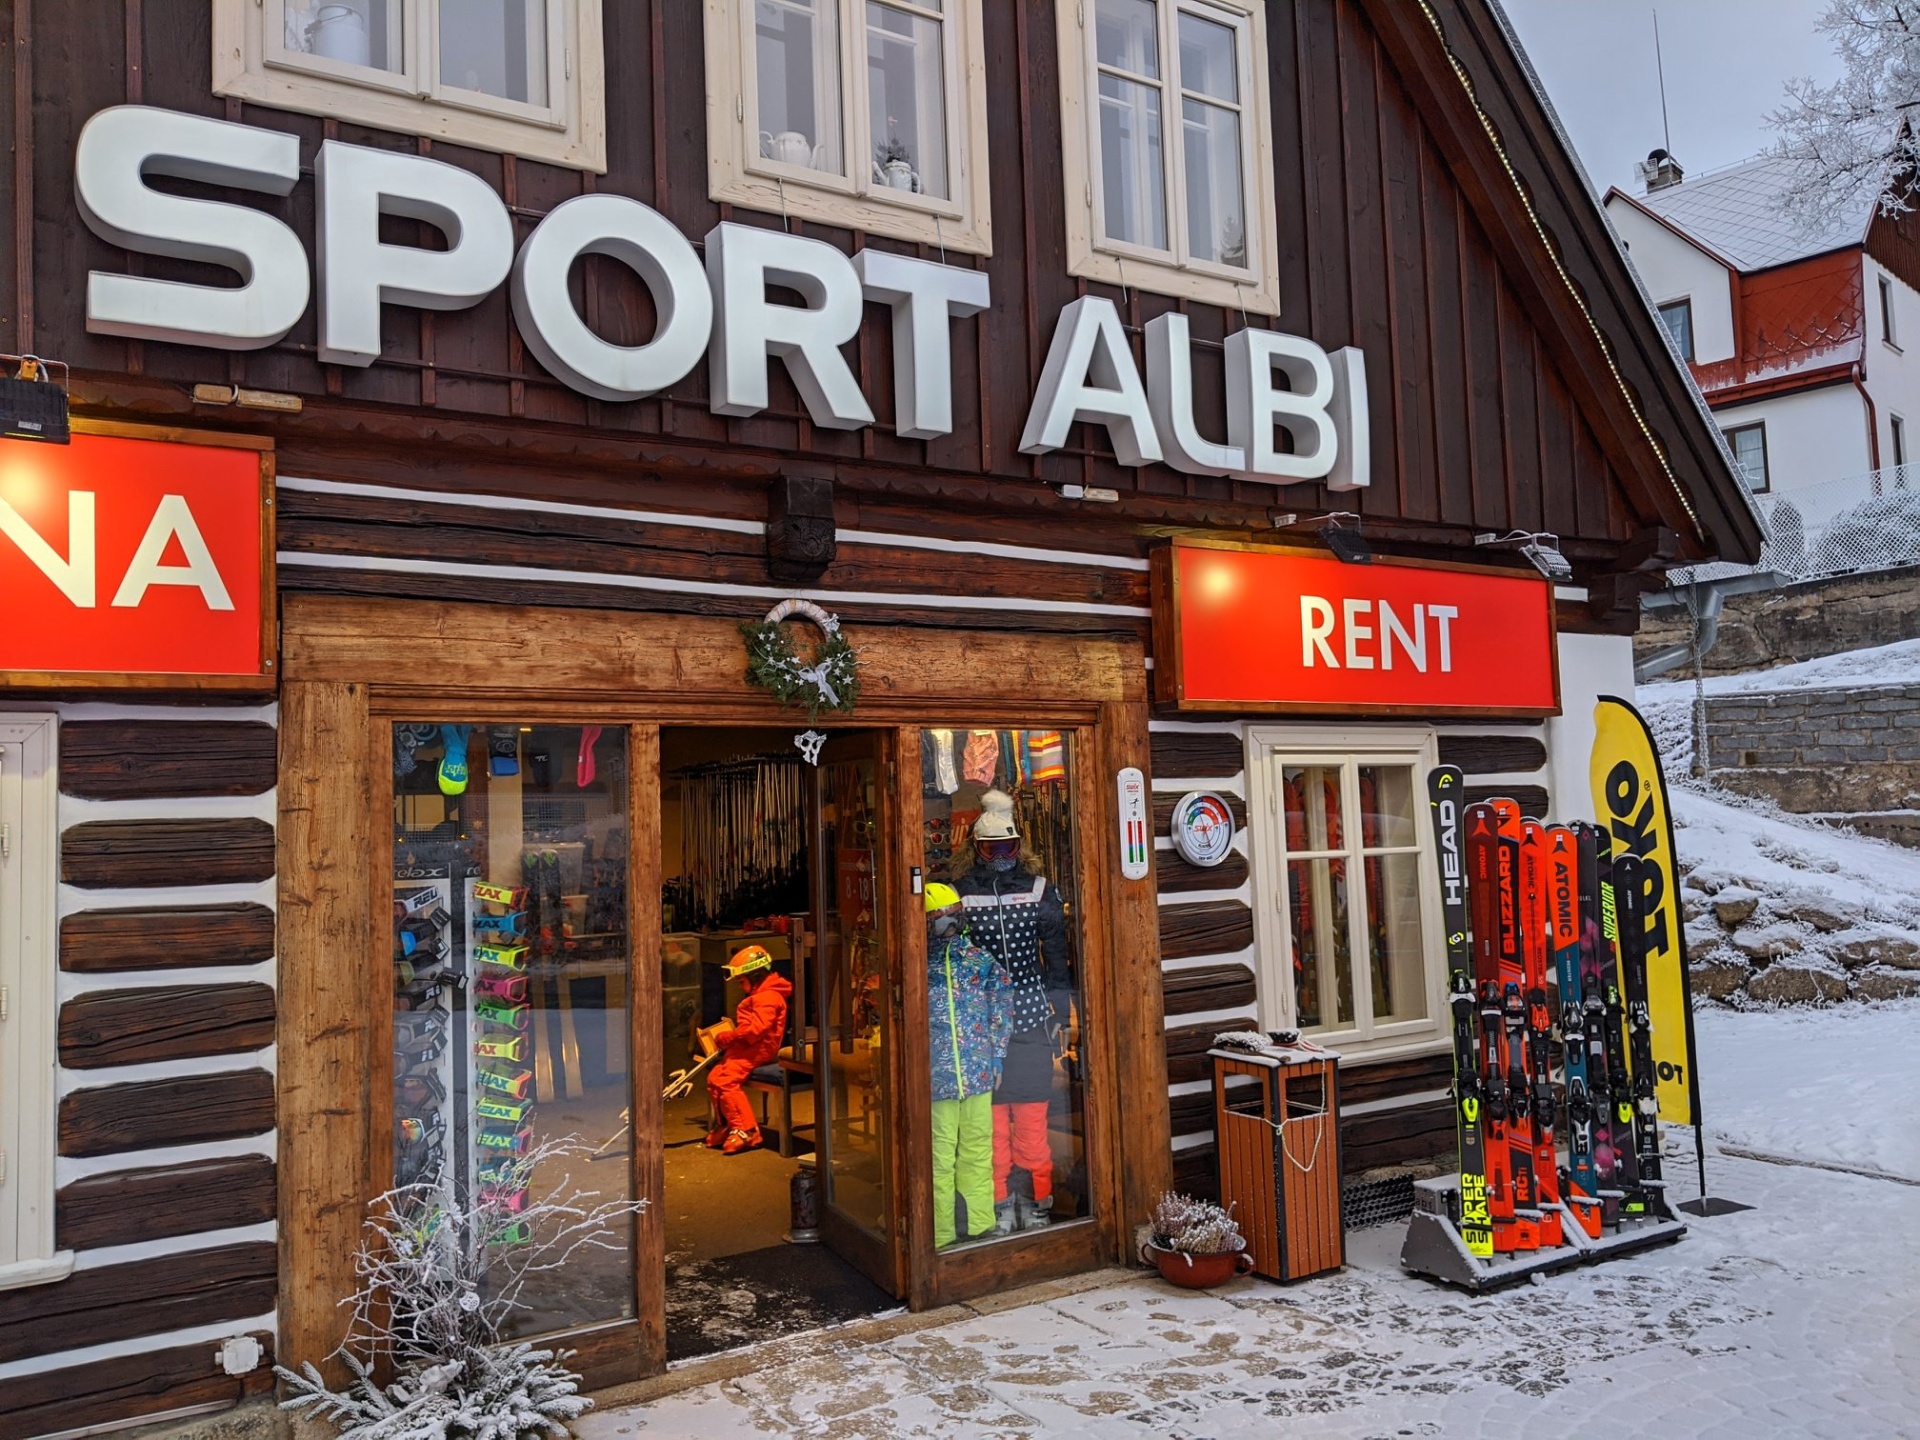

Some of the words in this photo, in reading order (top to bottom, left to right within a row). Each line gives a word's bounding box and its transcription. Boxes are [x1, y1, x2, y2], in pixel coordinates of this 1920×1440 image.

[75, 104, 990, 441] SPORT
[1018, 294, 1370, 492] ALBI
[0, 490, 237, 612] NA
[1300, 594, 1459, 674] RENT
[393, 866, 445, 878] elax
[1440, 800, 1462, 906] HEAD
[1478, 844, 1488, 880] ATOMIC
[1526, 854, 1536, 890] ATOMIC
[474, 885, 502, 901] LAX
[1498, 845, 1516, 955] BLIZZARD
[1554, 861, 1573, 939] ATOMIC
[1601, 881, 1615, 942] SUPERIOR
[1461, 1172, 1479, 1244] SUPER
[1473, 1174, 1490, 1244] SHAPE
